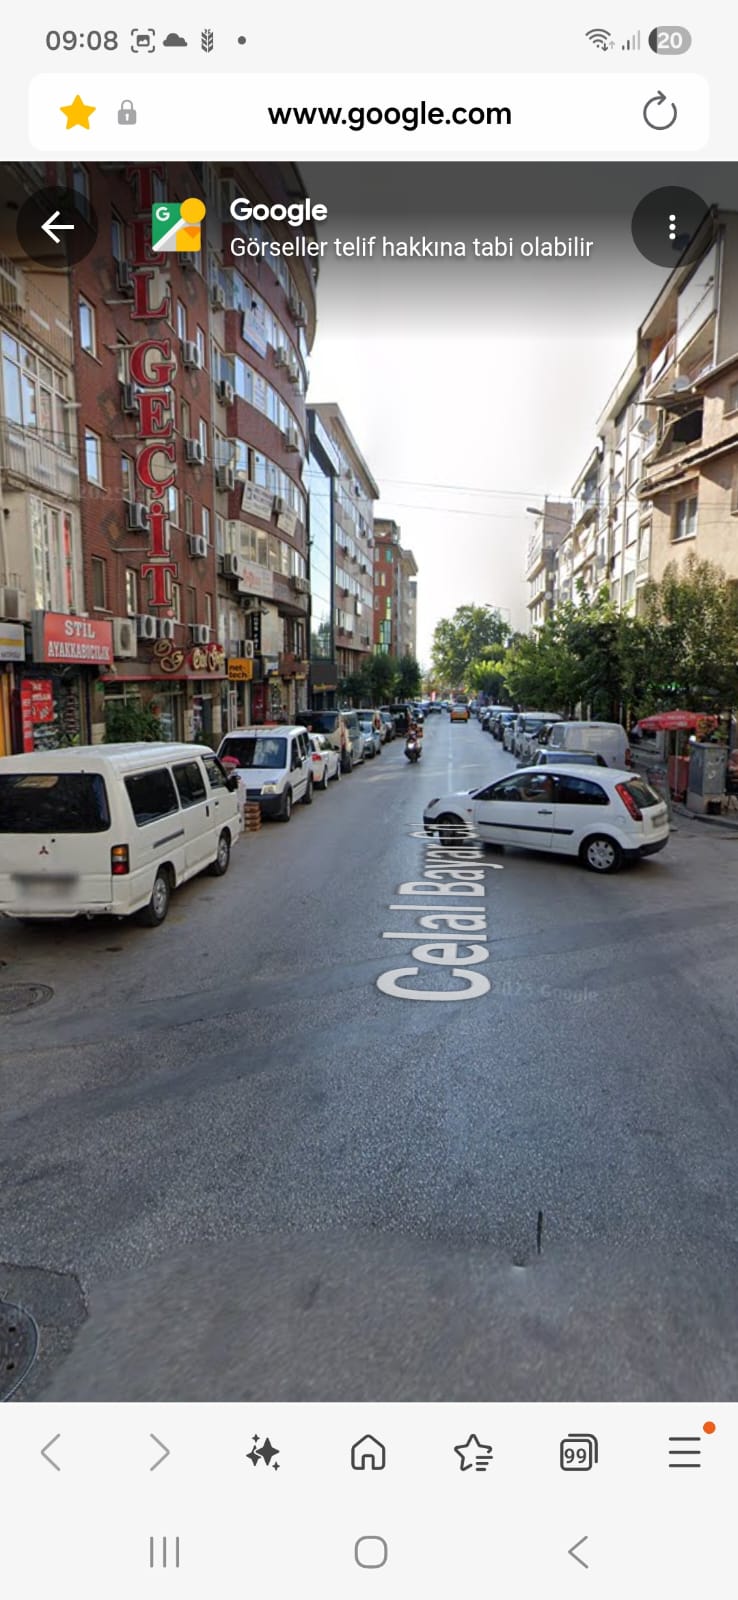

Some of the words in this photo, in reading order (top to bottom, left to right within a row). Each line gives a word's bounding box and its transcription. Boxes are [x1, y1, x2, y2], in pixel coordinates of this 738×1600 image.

[46, 31, 118, 50] 09:08
[658, 32, 682, 48] 20
[268, 101, 511, 131] www.google.com
[130, 339, 178, 607] GEÇİT
[64, 619, 96, 639] STİL
[564, 1447, 587, 1464] 99
